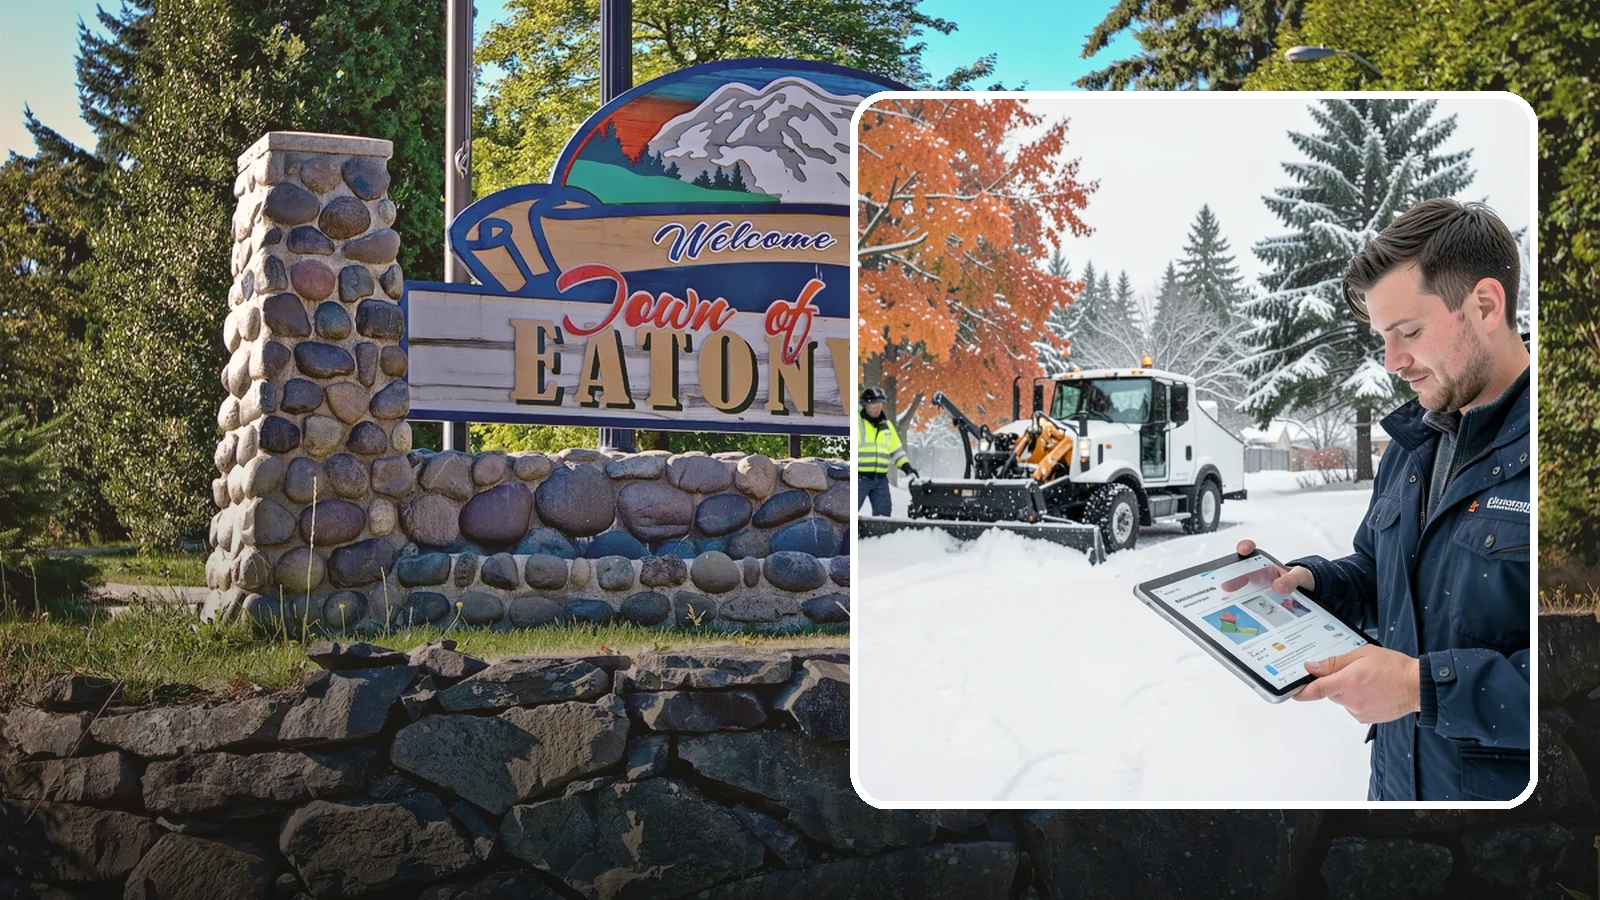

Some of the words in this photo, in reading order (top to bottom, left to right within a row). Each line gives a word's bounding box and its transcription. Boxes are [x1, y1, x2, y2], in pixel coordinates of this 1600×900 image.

[653, 220, 837, 263] Welcome
[557, 263, 737, 336] Town
[765, 279, 826, 365] of
